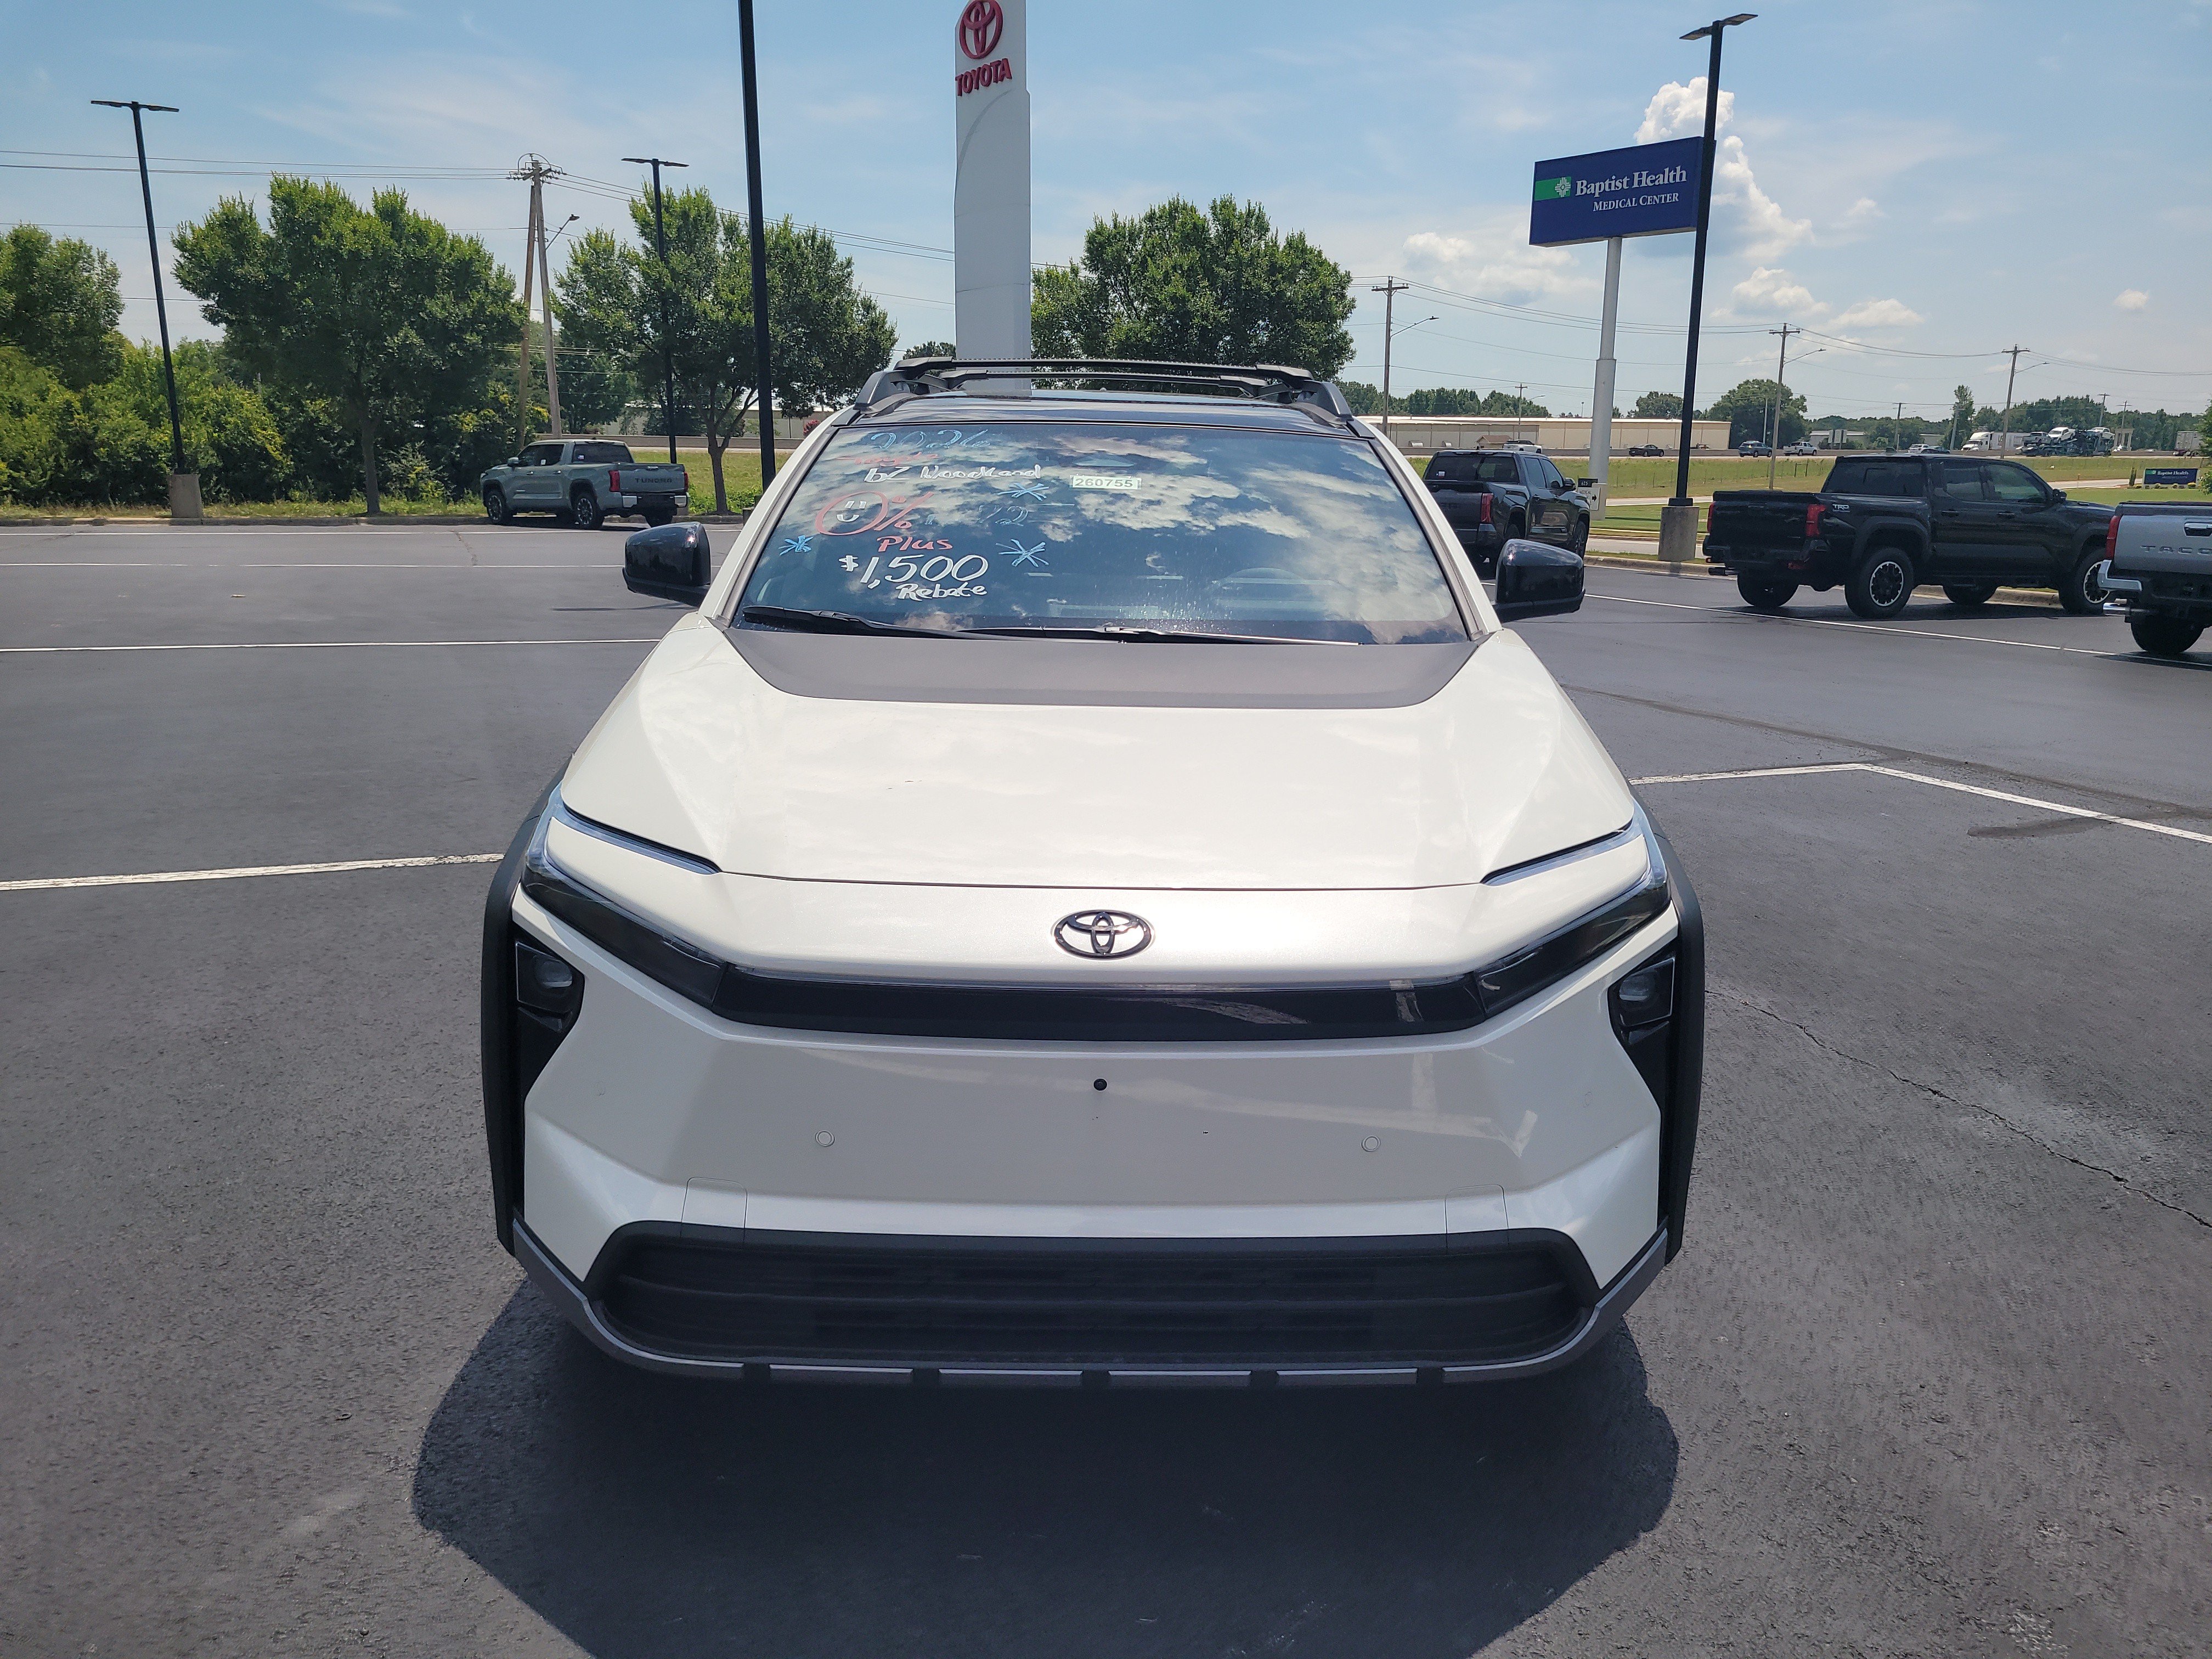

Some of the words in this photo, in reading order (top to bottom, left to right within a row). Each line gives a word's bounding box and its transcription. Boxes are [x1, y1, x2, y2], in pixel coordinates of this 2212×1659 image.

[955, 58, 1012, 97] TOYOTA
[1575, 176, 1630, 198] Baptist
[1632, 166, 1687, 188] Health
[1593, 197, 1638, 212] MEDICAL
[1639, 193, 1679, 206] CENTER
[1074, 478, 1133, 488] 260755
[877, 535, 953, 552] Plus
[838, 554, 988, 589] $1,500
[895, 582, 988, 601] Rebate
